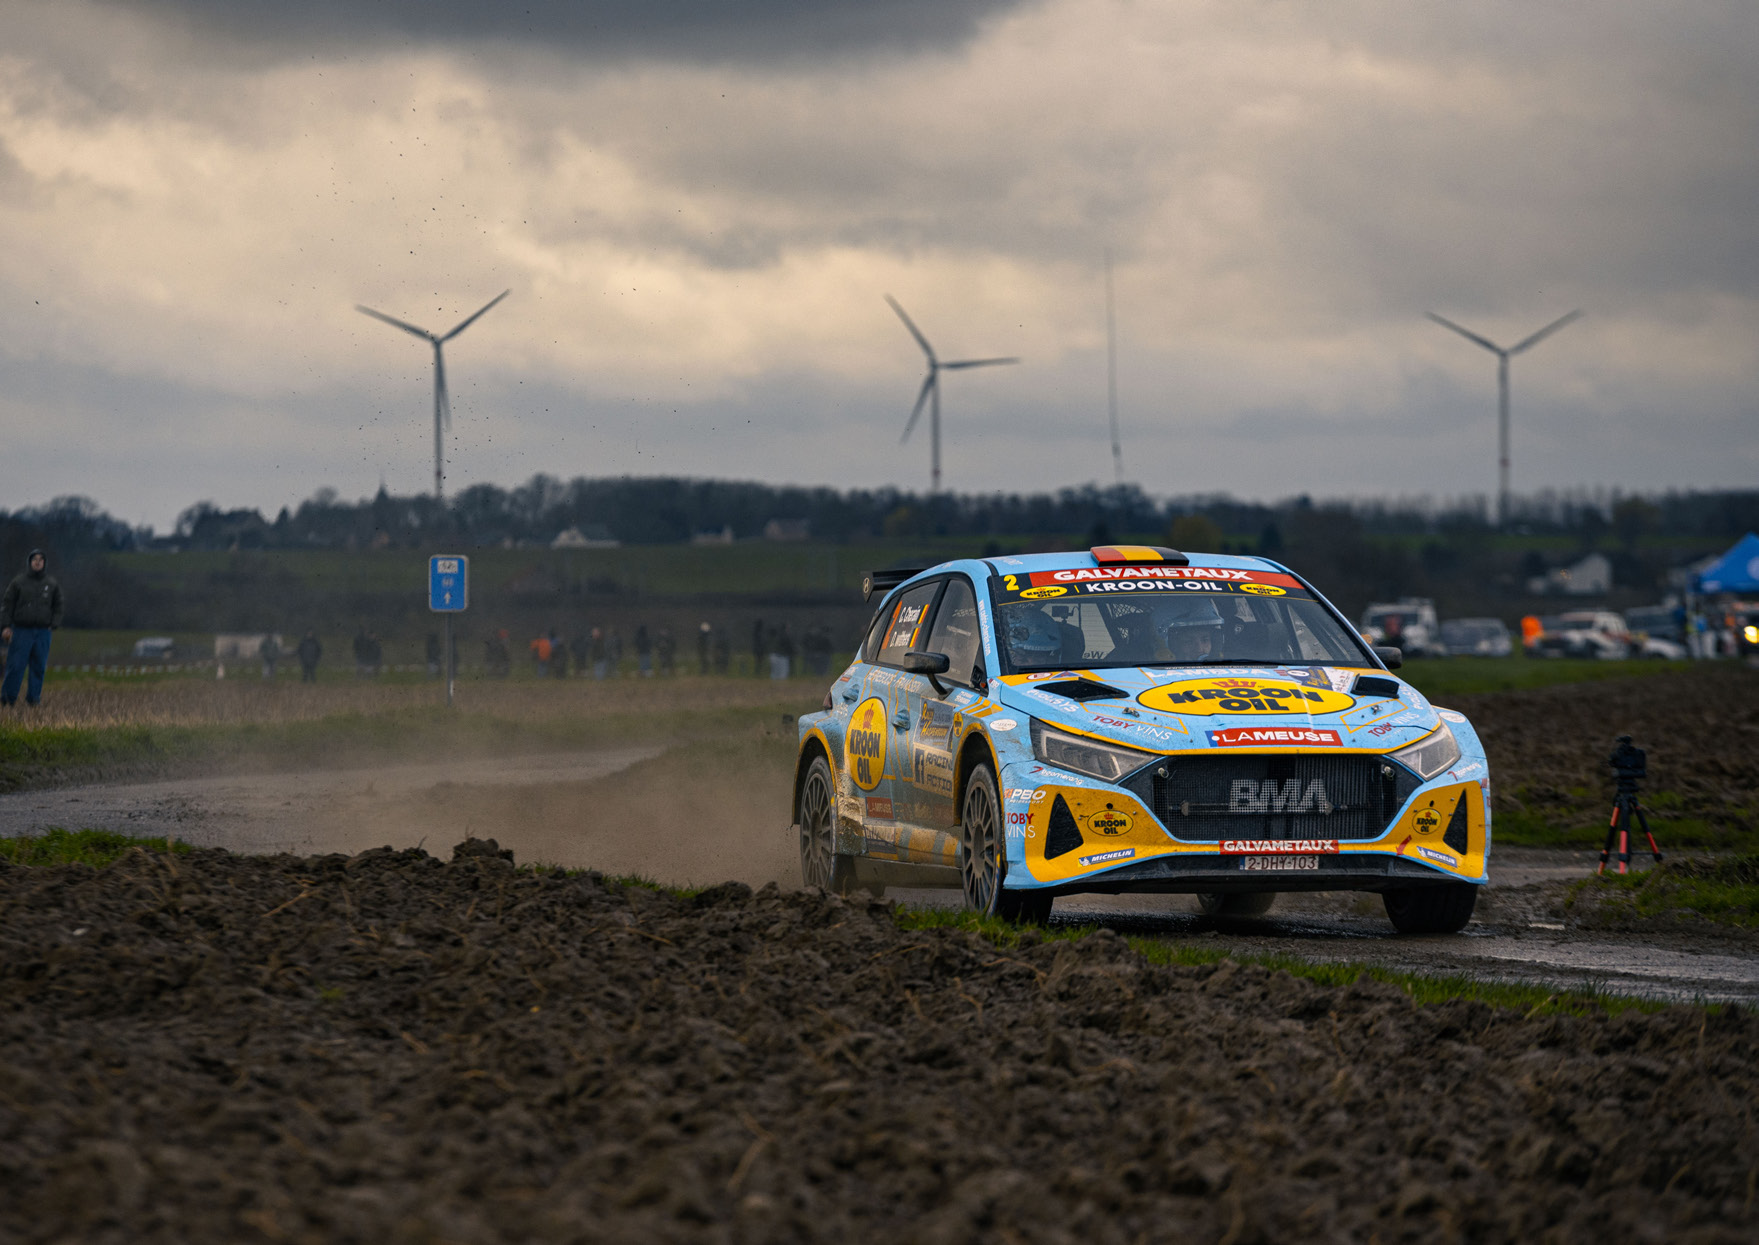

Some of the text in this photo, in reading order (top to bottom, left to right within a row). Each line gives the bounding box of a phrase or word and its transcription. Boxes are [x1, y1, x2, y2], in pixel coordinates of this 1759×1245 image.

[1053, 567, 1254, 581] GALVAMETAUX
[1003, 575, 1020, 591] 2
[1085, 580, 1223, 593] KROON-OIL
[1026, 588, 1061, 597] KROON
[1245, 586, 1280, 594] KROON
[1167, 688, 1324, 704] KROON
[1219, 698, 1290, 711] OIL
[1093, 715, 1134, 729] TOBY
[849, 729, 881, 759] KROON
[857, 758, 872, 785] OIL
[1041, 769, 1084, 785] boomerang
[1011, 788, 1047, 800] PBO
[1228, 778, 1327, 813] BMA
[1006, 812, 1035, 824] TOBY
[1094, 819, 1127, 828] KROON
[1416, 817, 1438, 826] KROON
[1006, 825, 1036, 838] VINS
[1103, 827, 1118, 835] OIL
[1420, 825, 1429, 833] OIL
[1223, 840, 1335, 852] GALVAMETAUX
[1091, 849, 1132, 862] MICHELIN
[1426, 850, 1455, 865] MICHELIN
[1248, 856, 1315, 870] 2-DHY-103
